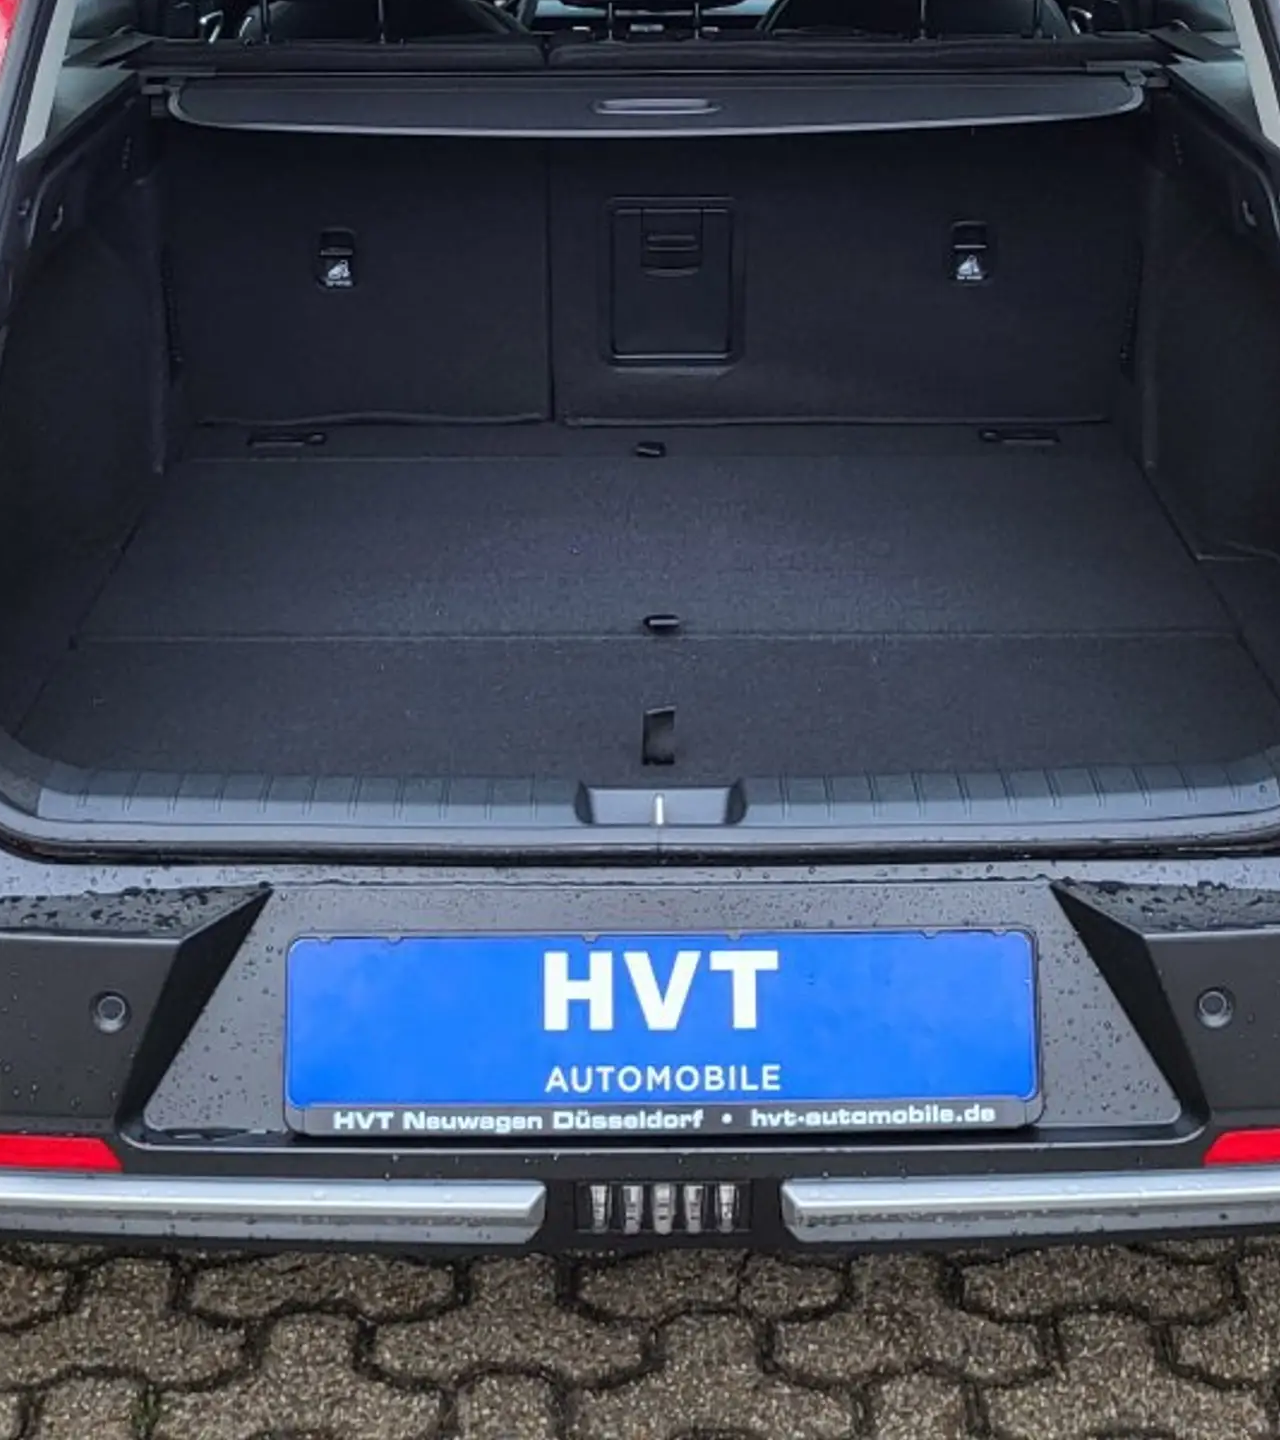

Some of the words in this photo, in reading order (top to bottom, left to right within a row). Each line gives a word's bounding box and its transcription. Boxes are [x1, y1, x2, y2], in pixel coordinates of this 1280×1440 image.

[543, 950, 779, 1031] HVT
[544, 1064, 782, 1093] AUTOMOBILE
[333, 1111, 394, 1130] HVT
[402, 1111, 544, 1134] Neuwagen
[552, 1108, 704, 1131] Düsseldorf
[750, 1104, 996, 1129] hvt-automobile.de
